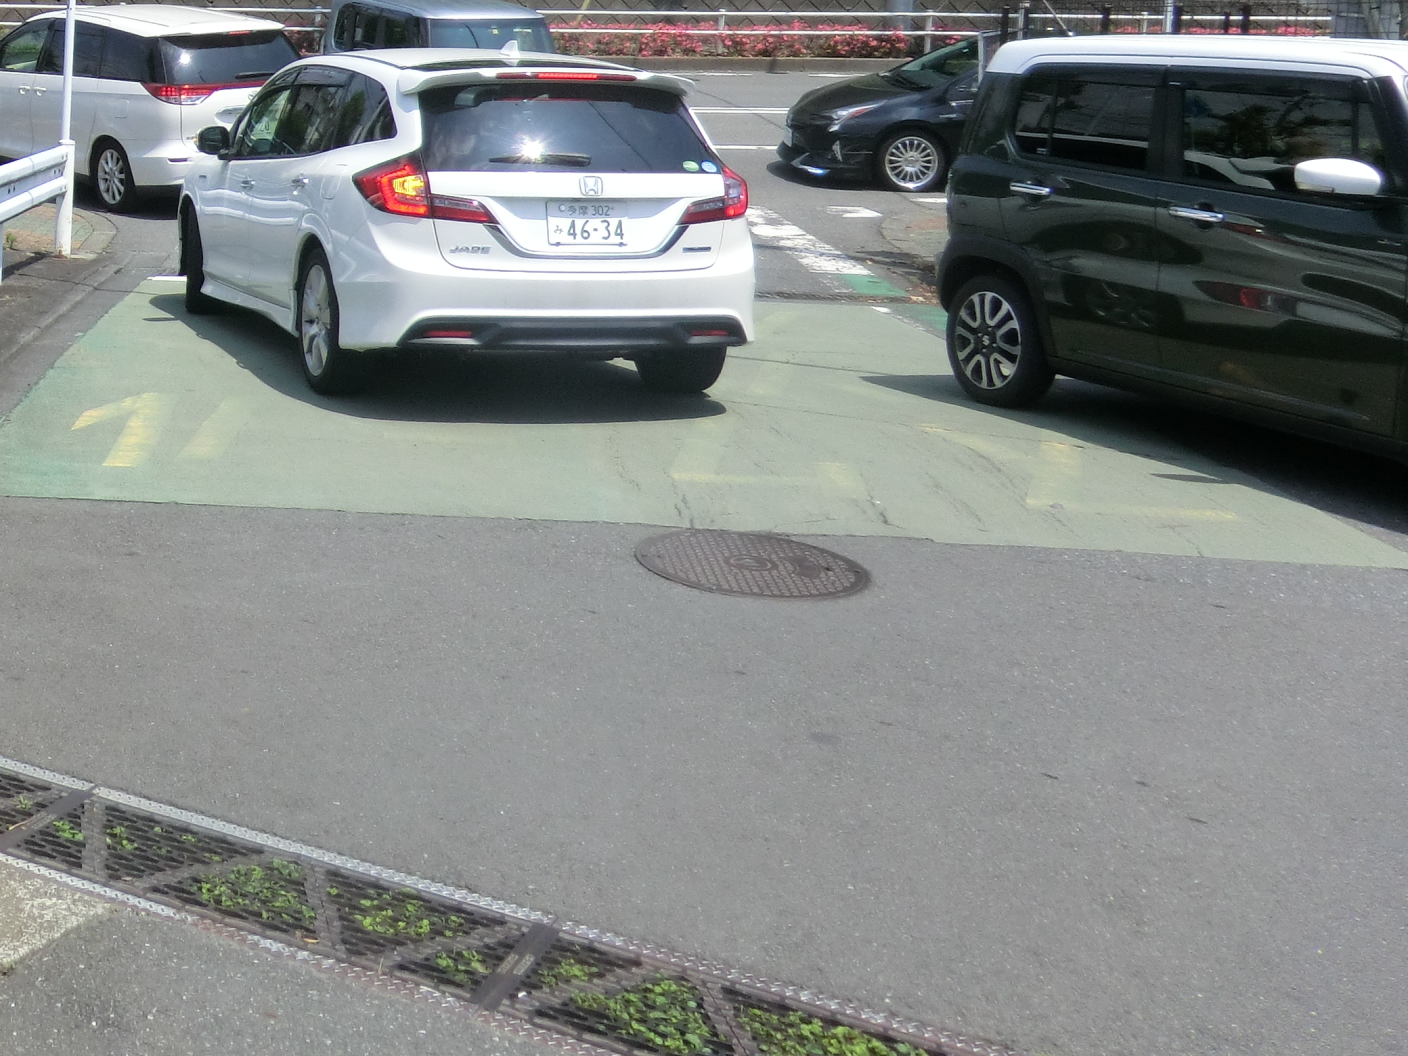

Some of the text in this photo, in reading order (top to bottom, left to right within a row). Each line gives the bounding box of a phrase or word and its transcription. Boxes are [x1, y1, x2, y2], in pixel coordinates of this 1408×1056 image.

[567, 205, 610, 216] 多摩 302
[567, 219, 624, 240] 46-34
